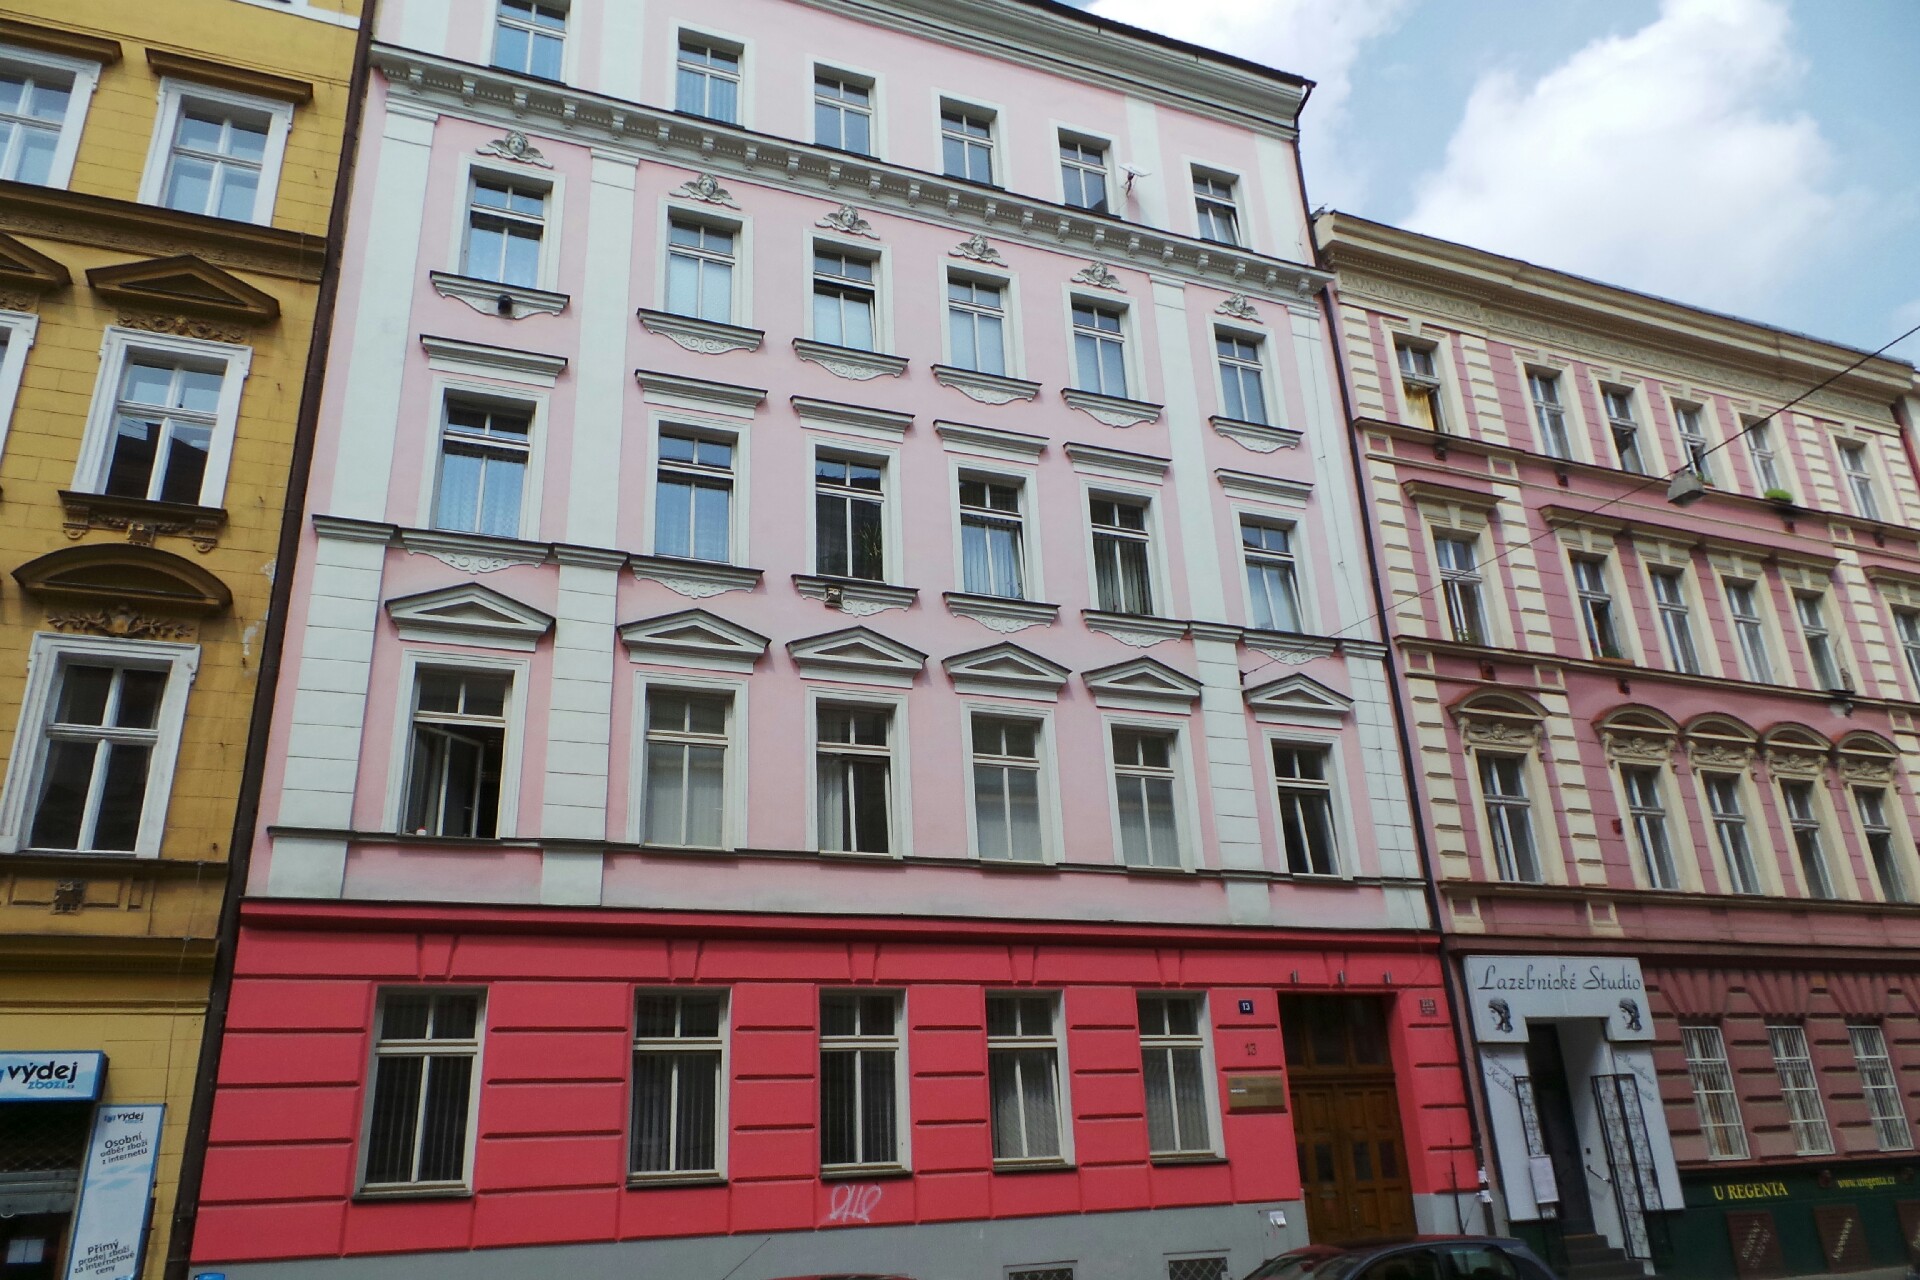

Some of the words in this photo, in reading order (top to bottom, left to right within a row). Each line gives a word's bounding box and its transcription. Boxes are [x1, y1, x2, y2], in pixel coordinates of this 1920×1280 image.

[1478, 964, 1577, 990] Lazebnické
[1582, 965, 1641, 990] Studio
[1242, 1002, 1251, 1011] 13
[1245, 1043, 1257, 1056] 13
[7, 1060, 78, 1083] výdej
[104, 1131, 143, 1149] Osobní
[108, 1147, 148, 1164] internetu
[1712, 1184, 1724, 1201] U
[1727, 1182, 1789, 1200] REGENTA
[87, 1238, 119, 1256] Přímý
[78, 1252, 107, 1267] prodej
[85, 1251, 136, 1271] internetové
[95, 1264, 116, 1275] ceny
